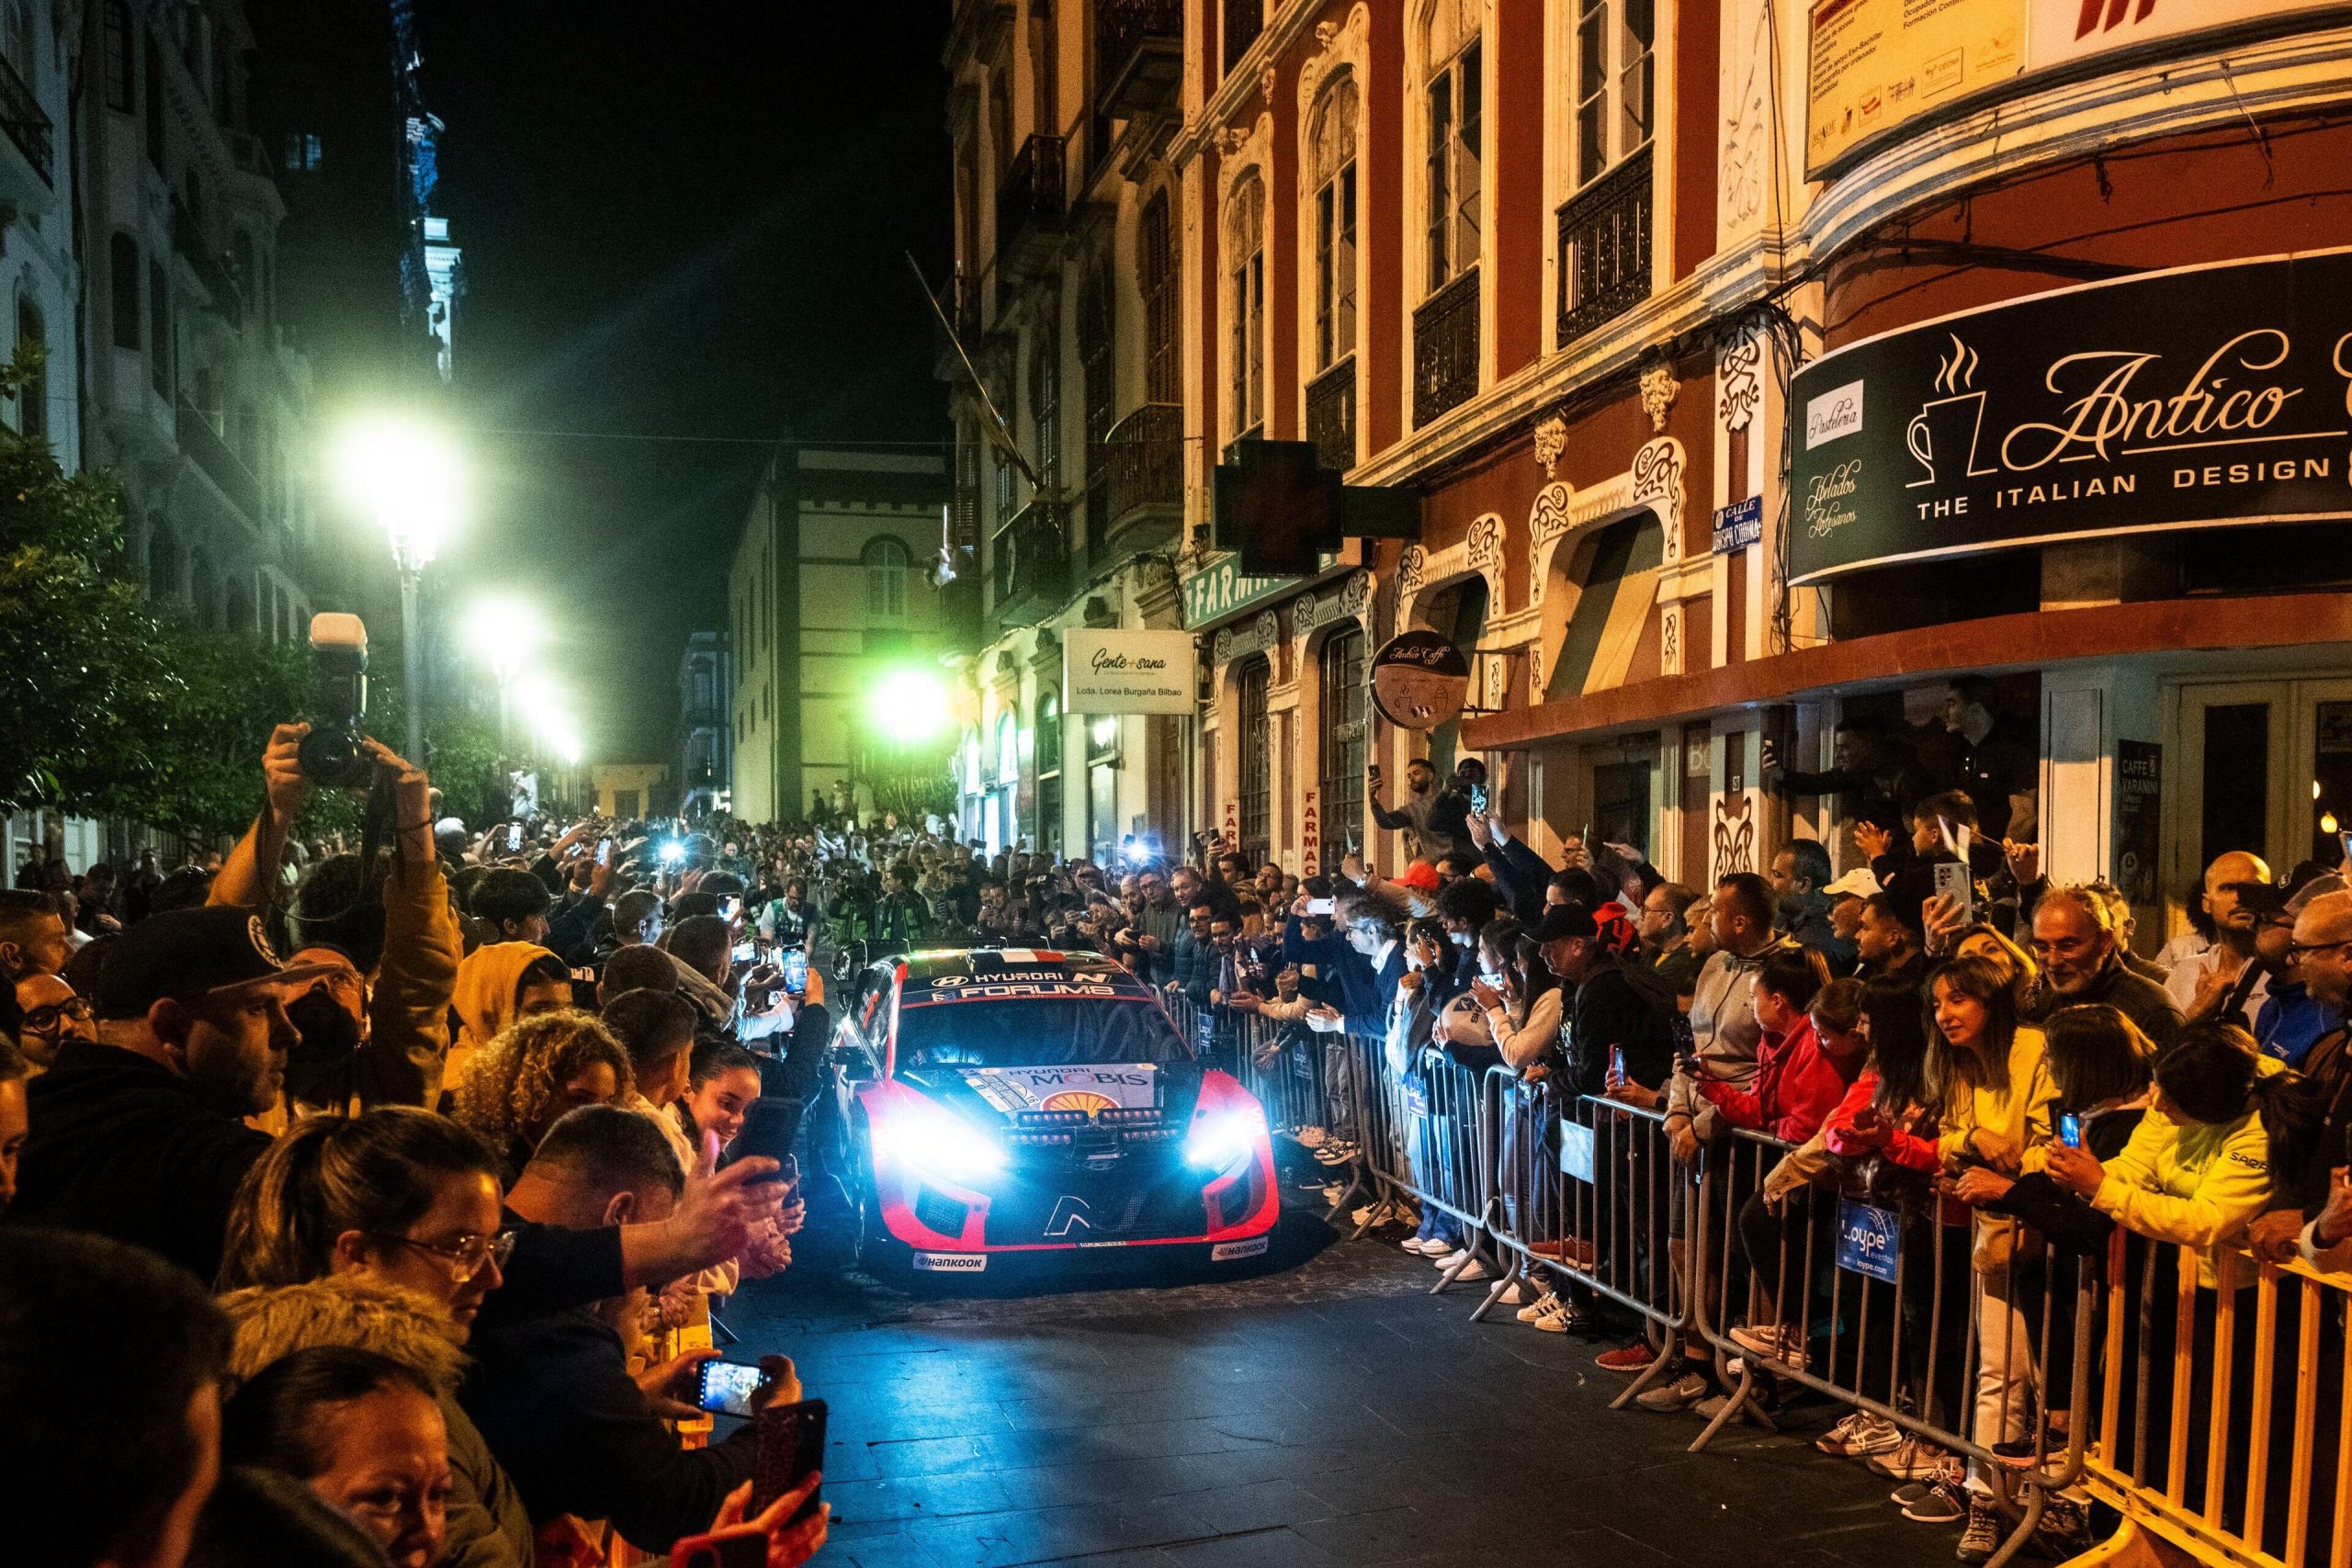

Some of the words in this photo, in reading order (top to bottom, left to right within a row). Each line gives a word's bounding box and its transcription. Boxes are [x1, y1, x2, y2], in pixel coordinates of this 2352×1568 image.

[2001, 329, 2303, 471] Antico
[1807, 459, 1861, 511] Helados
[1917, 496, 1969, 521] THE
[1996, 474, 2136, 509] ITALIAN
[2174, 457, 2330, 489] DESIGN
[1725, 500, 1756, 518] CALLE
[1805, 502, 1858, 538] Artesanos
[1099, 686, 1122, 695] Lorea
[1124, 687, 1156, 698] Burgaña
[1158, 687, 1183, 697] Bilbao
[975, 972, 1063, 983] HYUNDAI
[960, 985, 1114, 998] FORUM8
[1009, 1067, 1091, 1076] HYUNDAI
[1030, 1073, 1148, 1086] MOBIS
[1870, 1252, 1894, 1265] eventos
